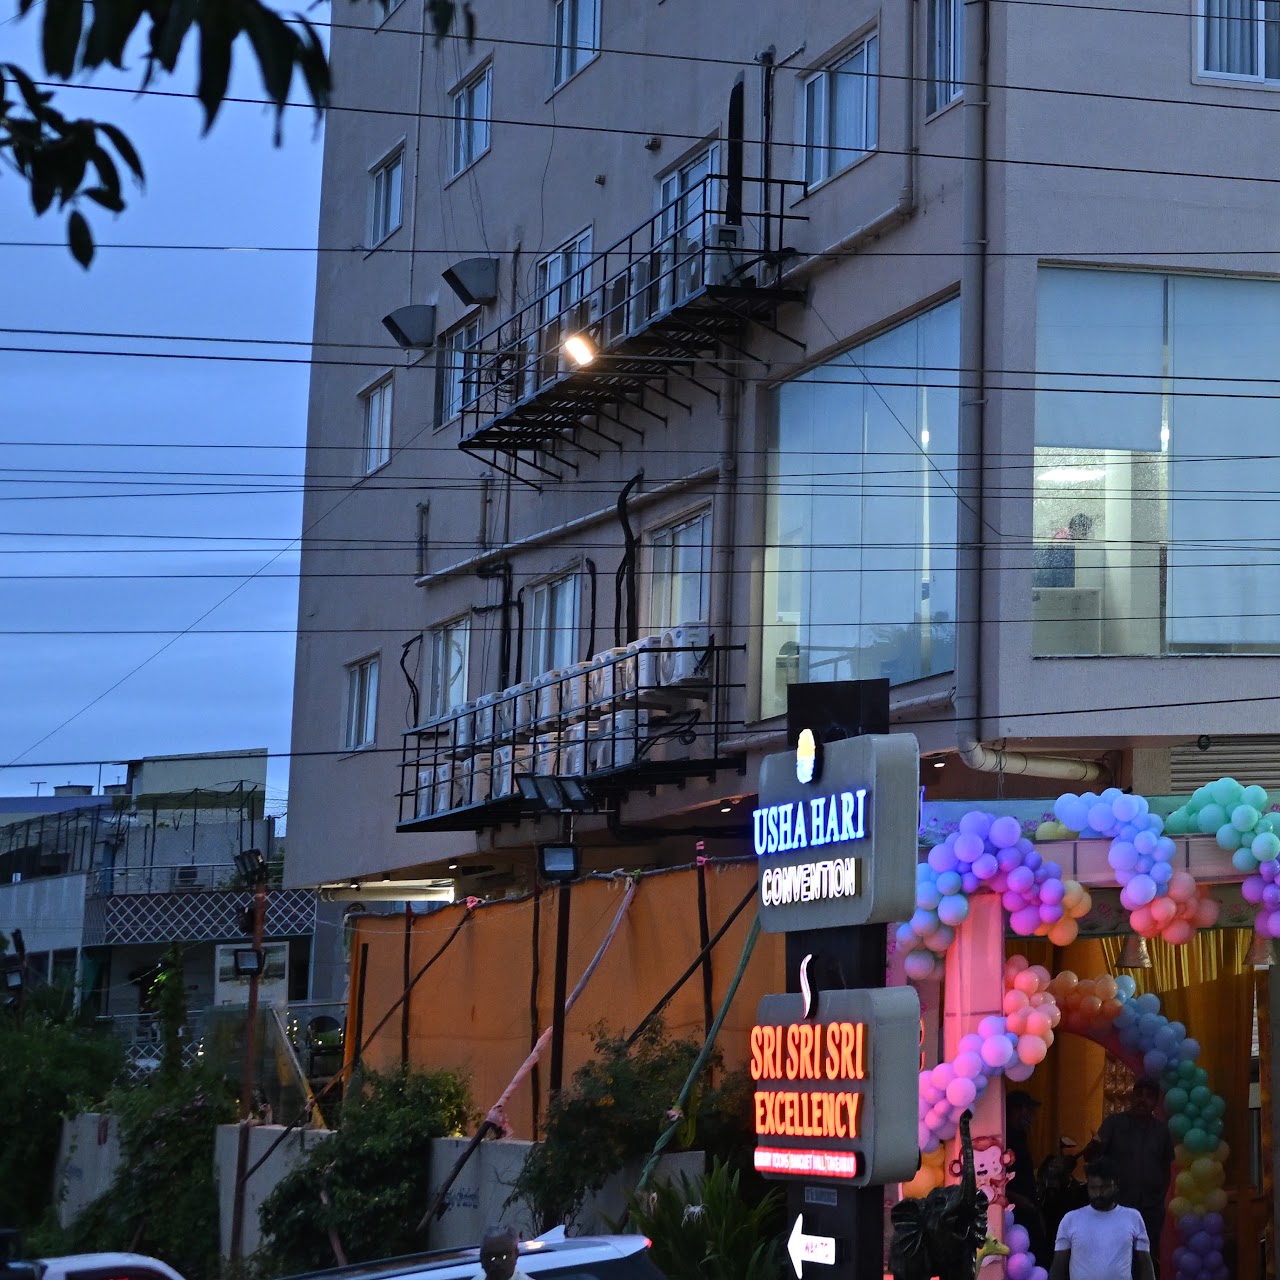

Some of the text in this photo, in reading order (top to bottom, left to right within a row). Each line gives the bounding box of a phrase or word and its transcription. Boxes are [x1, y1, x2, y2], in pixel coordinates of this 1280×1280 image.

[753, 789, 866, 856] USHA HARI
[762, 857, 856, 906] CONVENTION
[750, 1022, 864, 1080] SRI SRI SRI
[754, 1091, 860, 1138] EXCELLENCY
